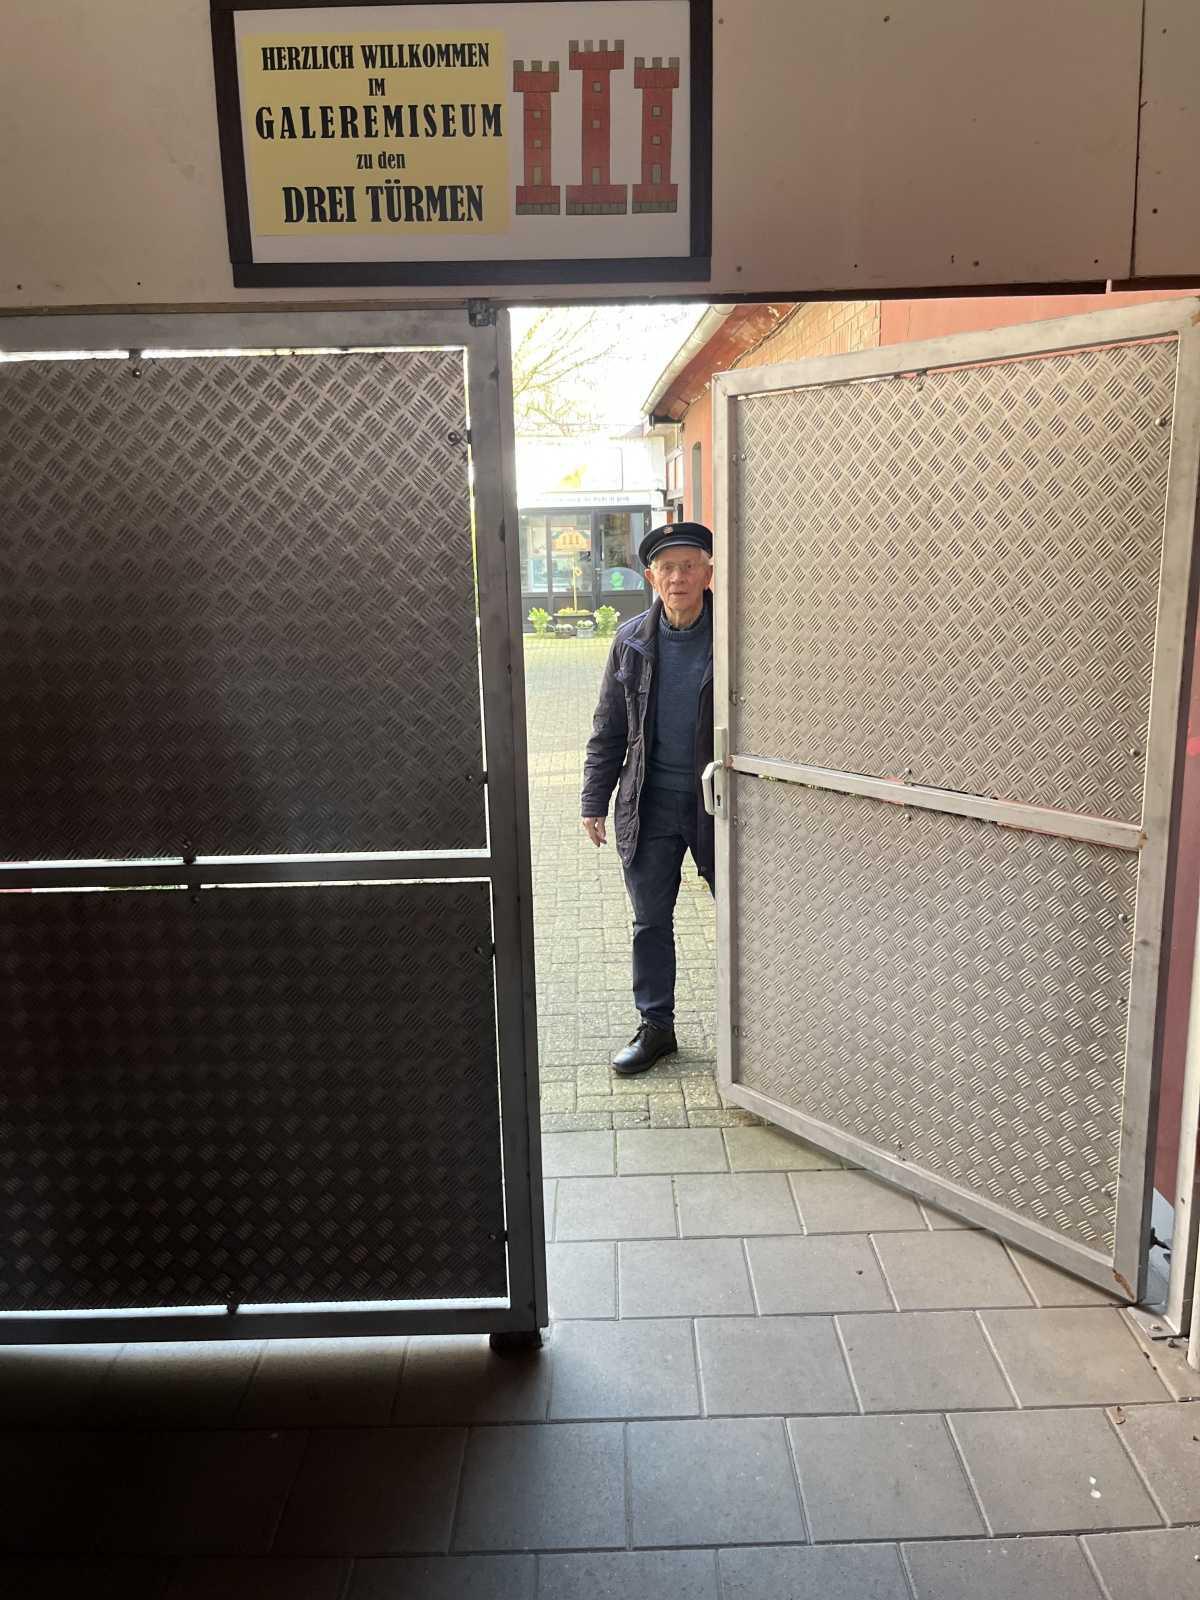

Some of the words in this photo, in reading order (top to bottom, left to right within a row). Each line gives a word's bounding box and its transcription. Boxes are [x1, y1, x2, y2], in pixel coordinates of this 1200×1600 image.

[261, 45, 354, 71] HERZLICH
[361, 43, 489, 68] WILLKOMMEN
[368, 78, 385, 96] IM
[256, 104, 502, 139] GALEREMISEUM
[357, 154, 373, 169] zu
[378, 151, 405, 169] den
[282, 186, 357, 223] DREI
[366, 179, 483, 222] TÜRMEN
